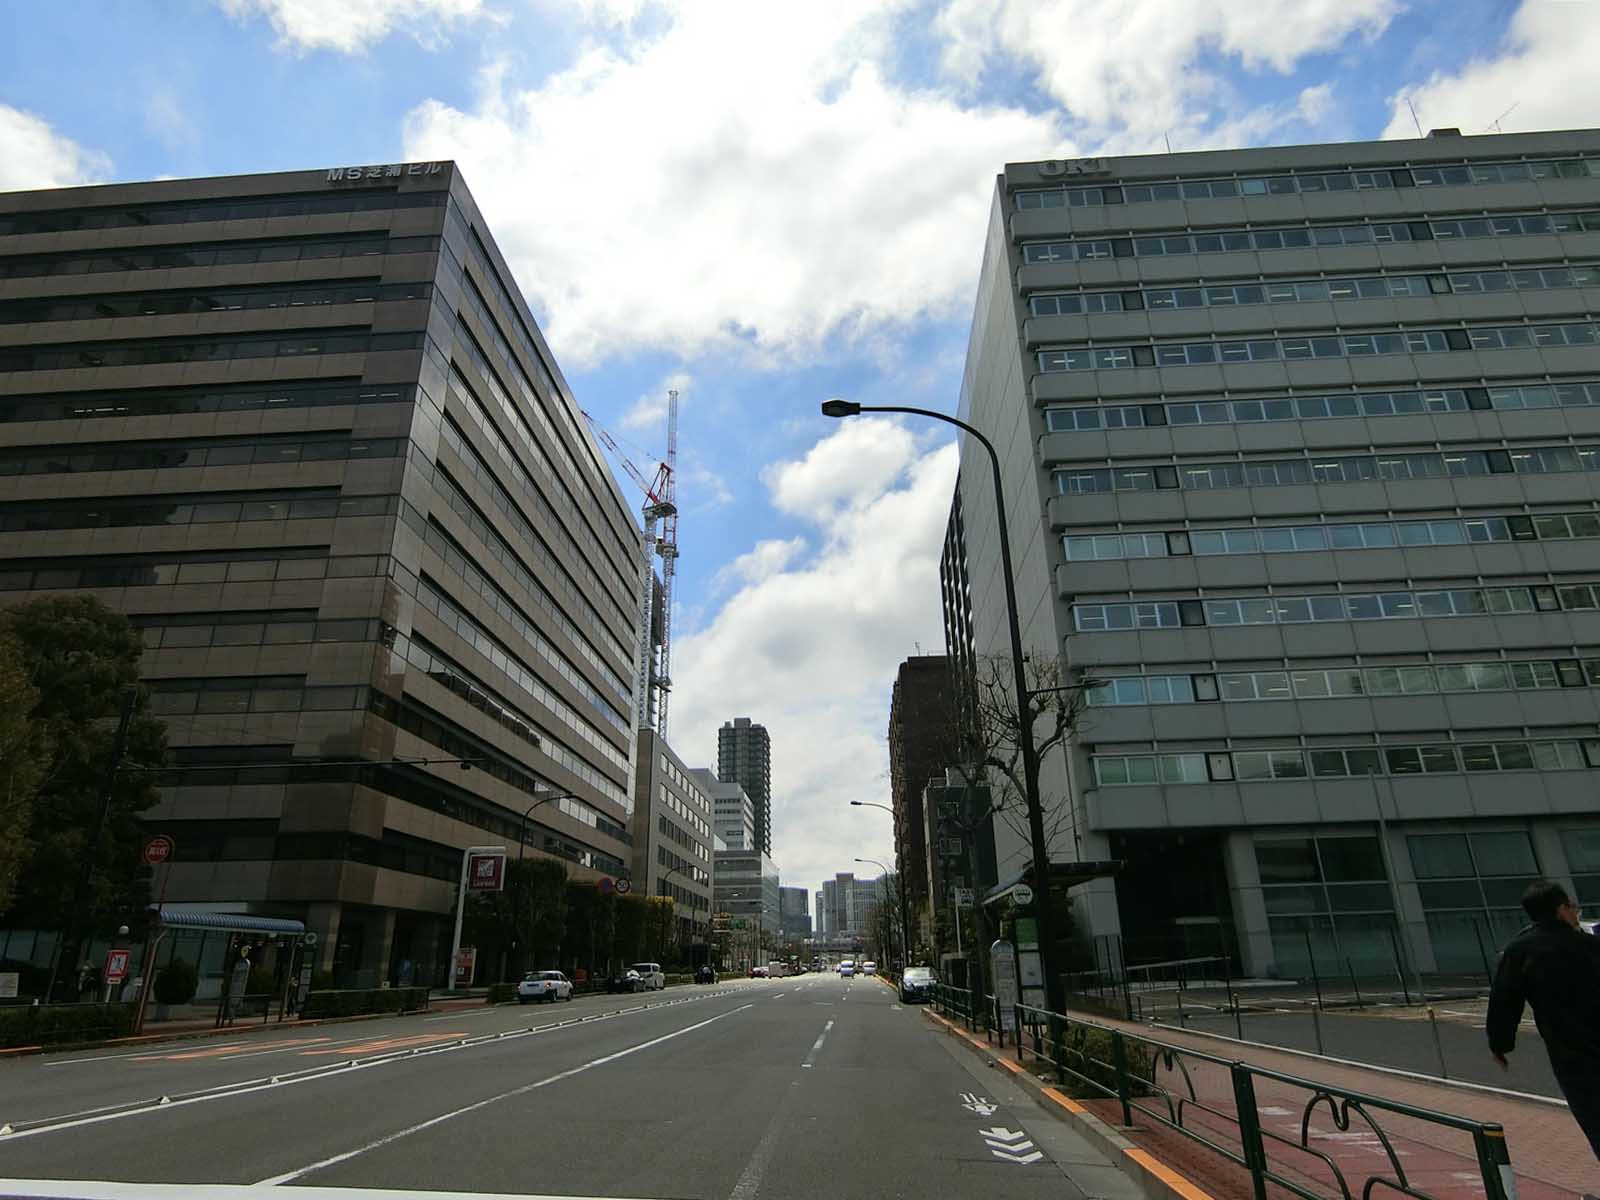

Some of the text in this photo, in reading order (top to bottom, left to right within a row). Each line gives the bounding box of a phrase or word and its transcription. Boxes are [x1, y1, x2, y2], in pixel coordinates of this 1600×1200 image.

[327, 162, 442, 181] MS芝浦ビル
[1039, 158, 1112, 176] OKI
